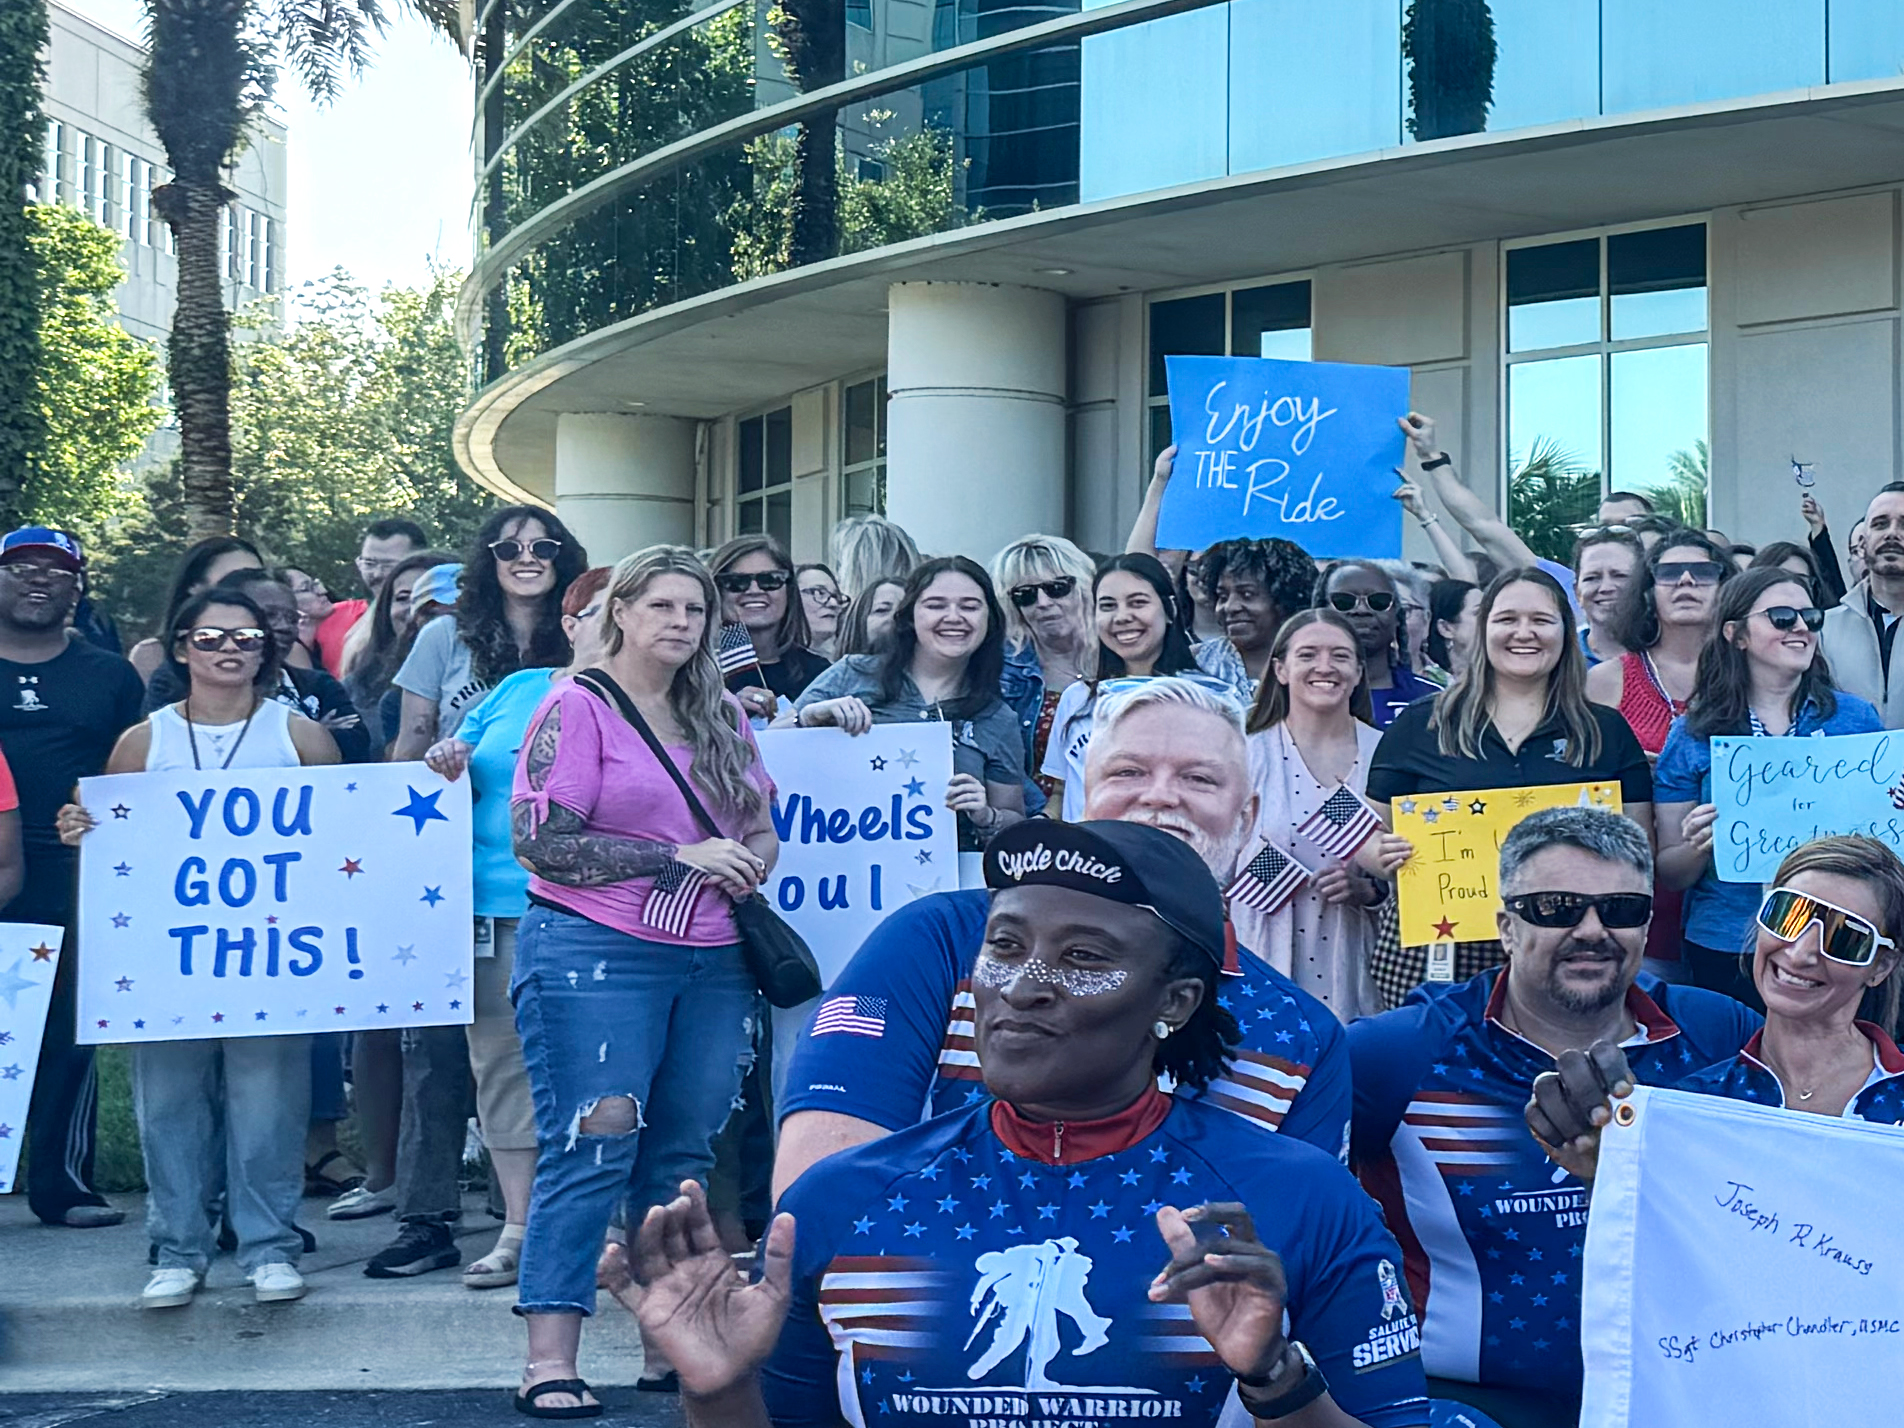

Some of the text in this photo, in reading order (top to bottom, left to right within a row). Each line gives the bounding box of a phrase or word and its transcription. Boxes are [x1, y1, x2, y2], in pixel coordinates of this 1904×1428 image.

[1204, 380, 1338, 456] Enjoy
[1194, 450, 1239, 489] THE
[1242, 458, 1346, 523] Ride
[1728, 735, 1896, 807] Geared
[176, 784, 313, 840] YOU
[1430, 829, 1474, 862] I'm
[173, 852, 302, 909] GOT
[1438, 872, 1488, 905] Proud
[1714, 1180, 1780, 1234] Joseph
[892, 1393, 1182, 1418] WOUNDED WARRIOR
